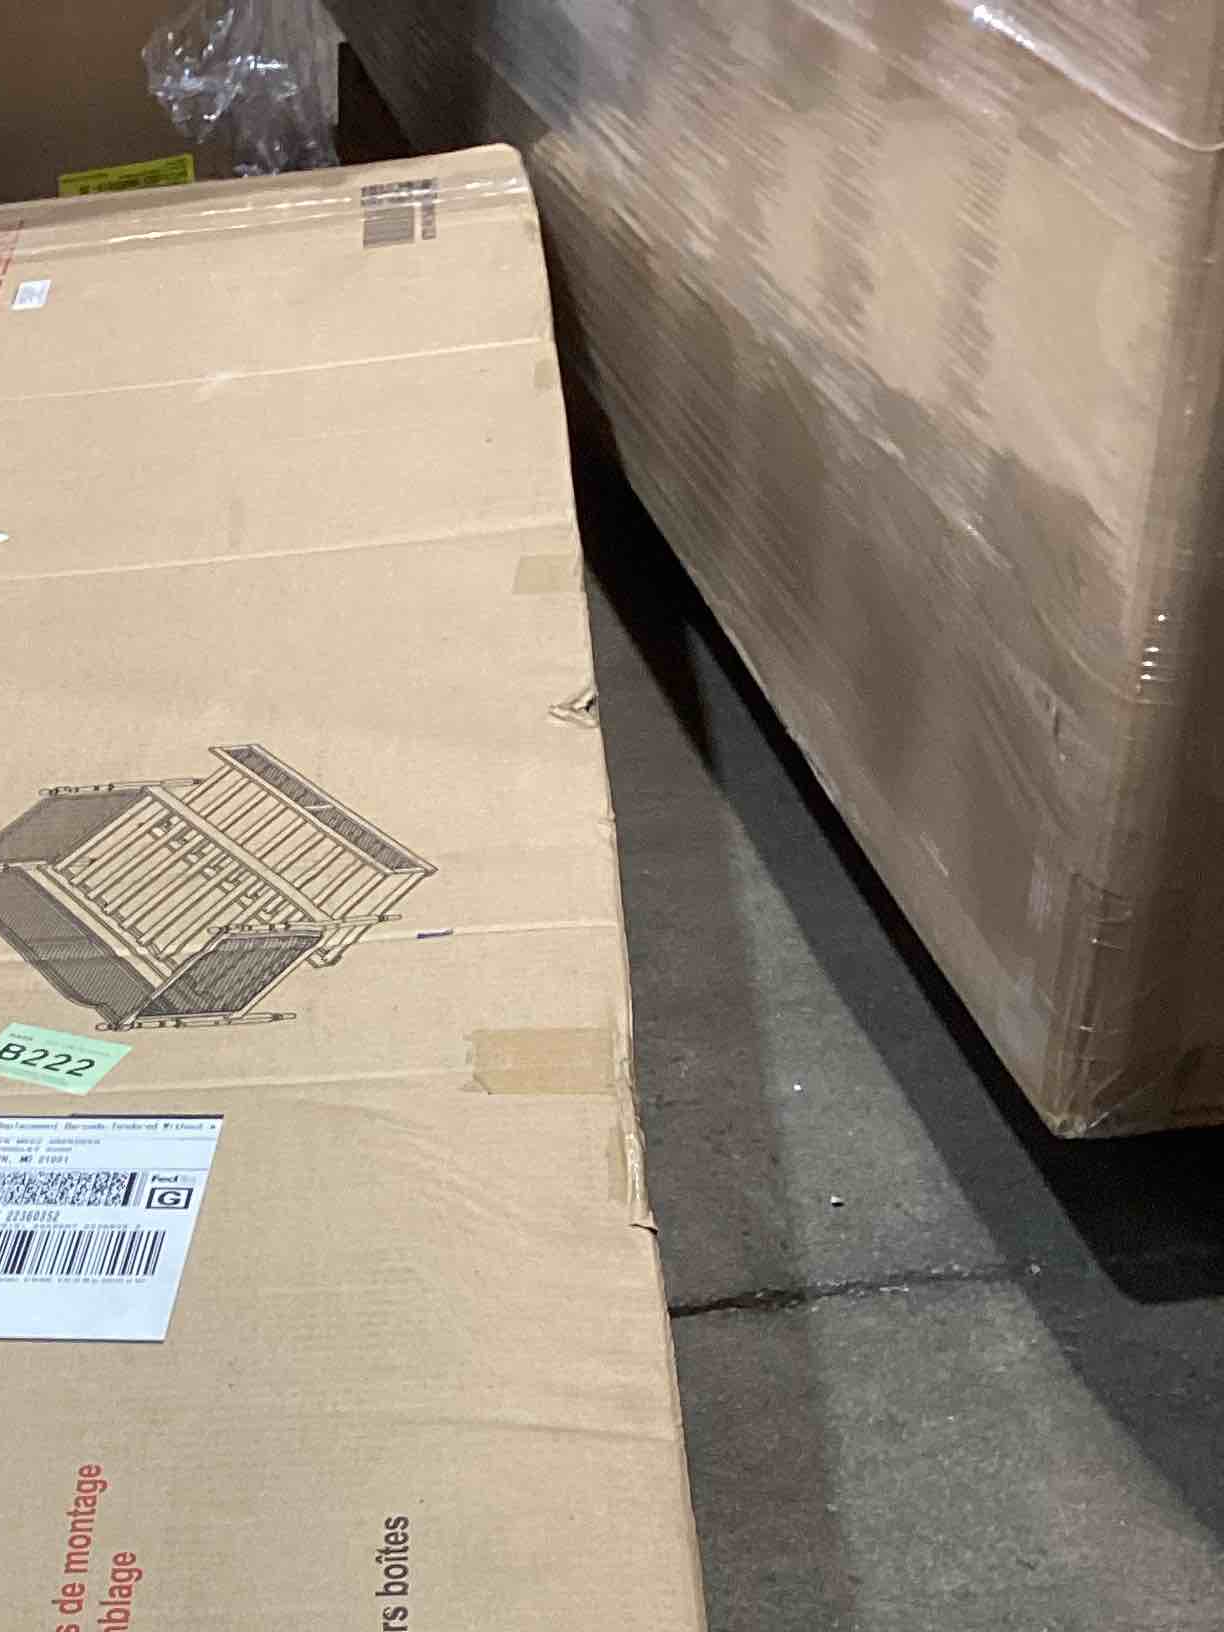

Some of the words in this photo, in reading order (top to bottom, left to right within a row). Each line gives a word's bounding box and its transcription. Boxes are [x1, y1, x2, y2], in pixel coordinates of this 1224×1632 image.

[157, 1190, 182, 1206] G
[64, 1463, 109, 1575] montage
[375, 1515, 410, 1598] boîtes
[51, 1581, 87, 1617] de
